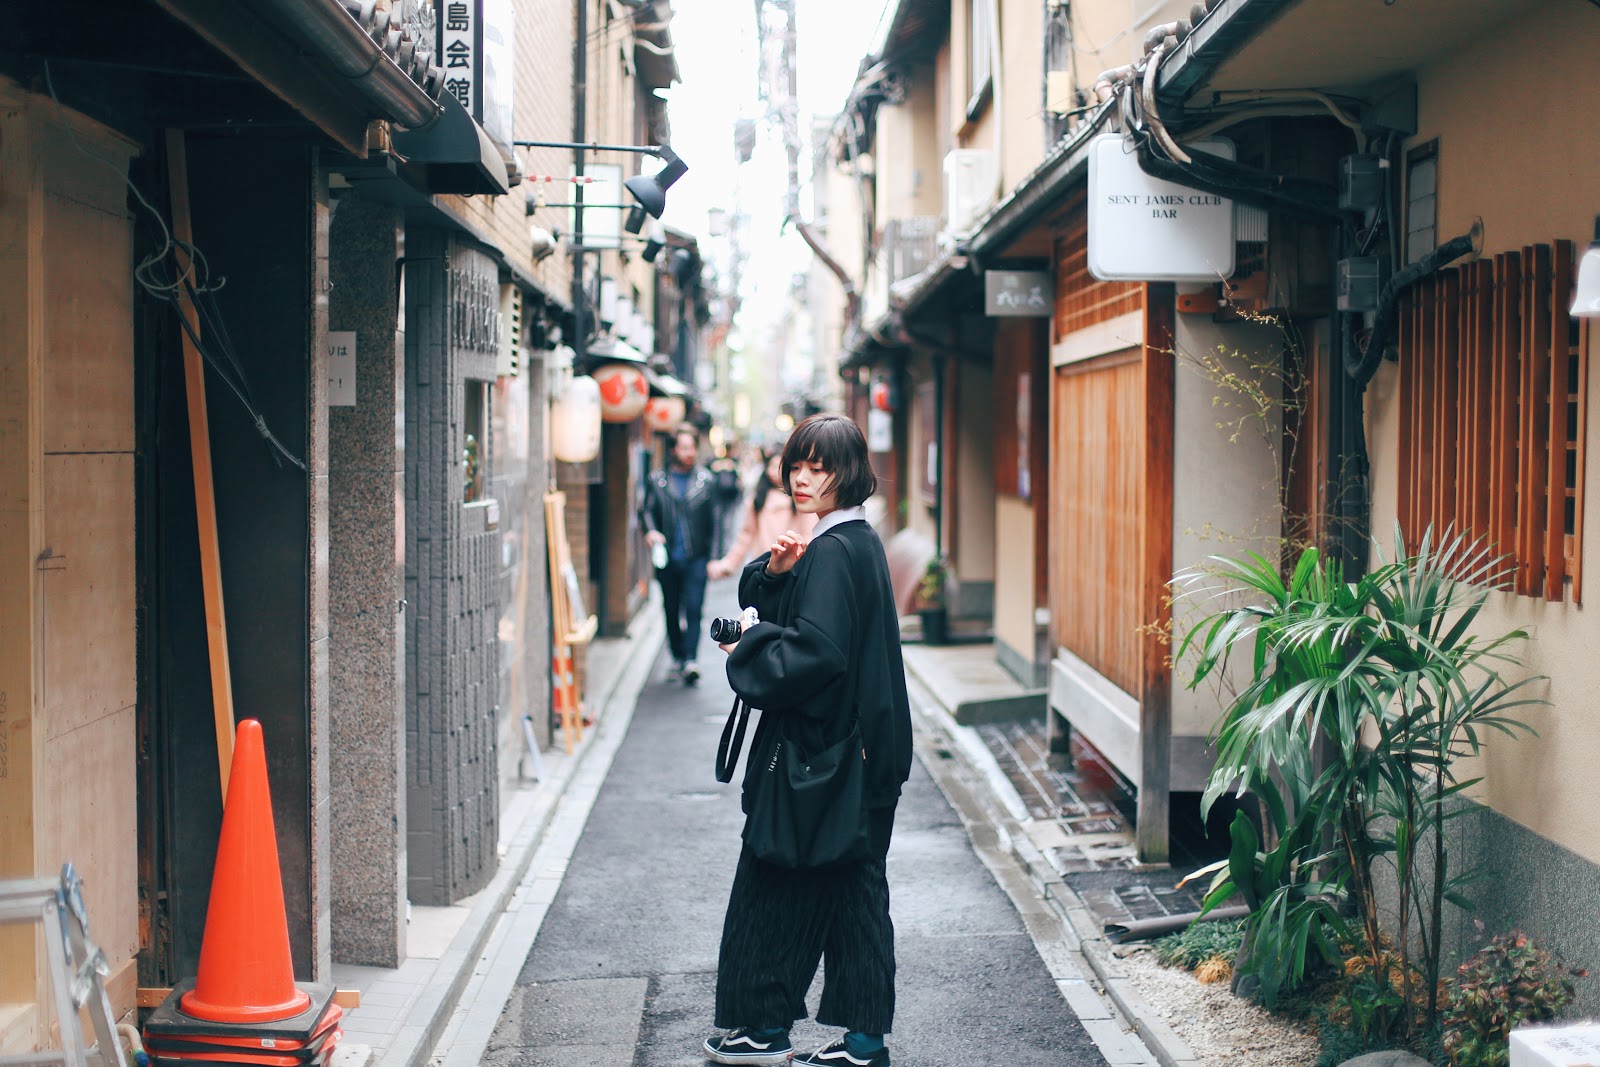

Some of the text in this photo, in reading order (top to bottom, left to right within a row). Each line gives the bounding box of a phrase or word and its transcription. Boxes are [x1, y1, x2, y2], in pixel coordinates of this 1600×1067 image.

[446, 1, 470, 107] 島会館
[1108, 195, 1222, 205] SENT JAMES CLUB
[1152, 209, 1177, 219] BAR
